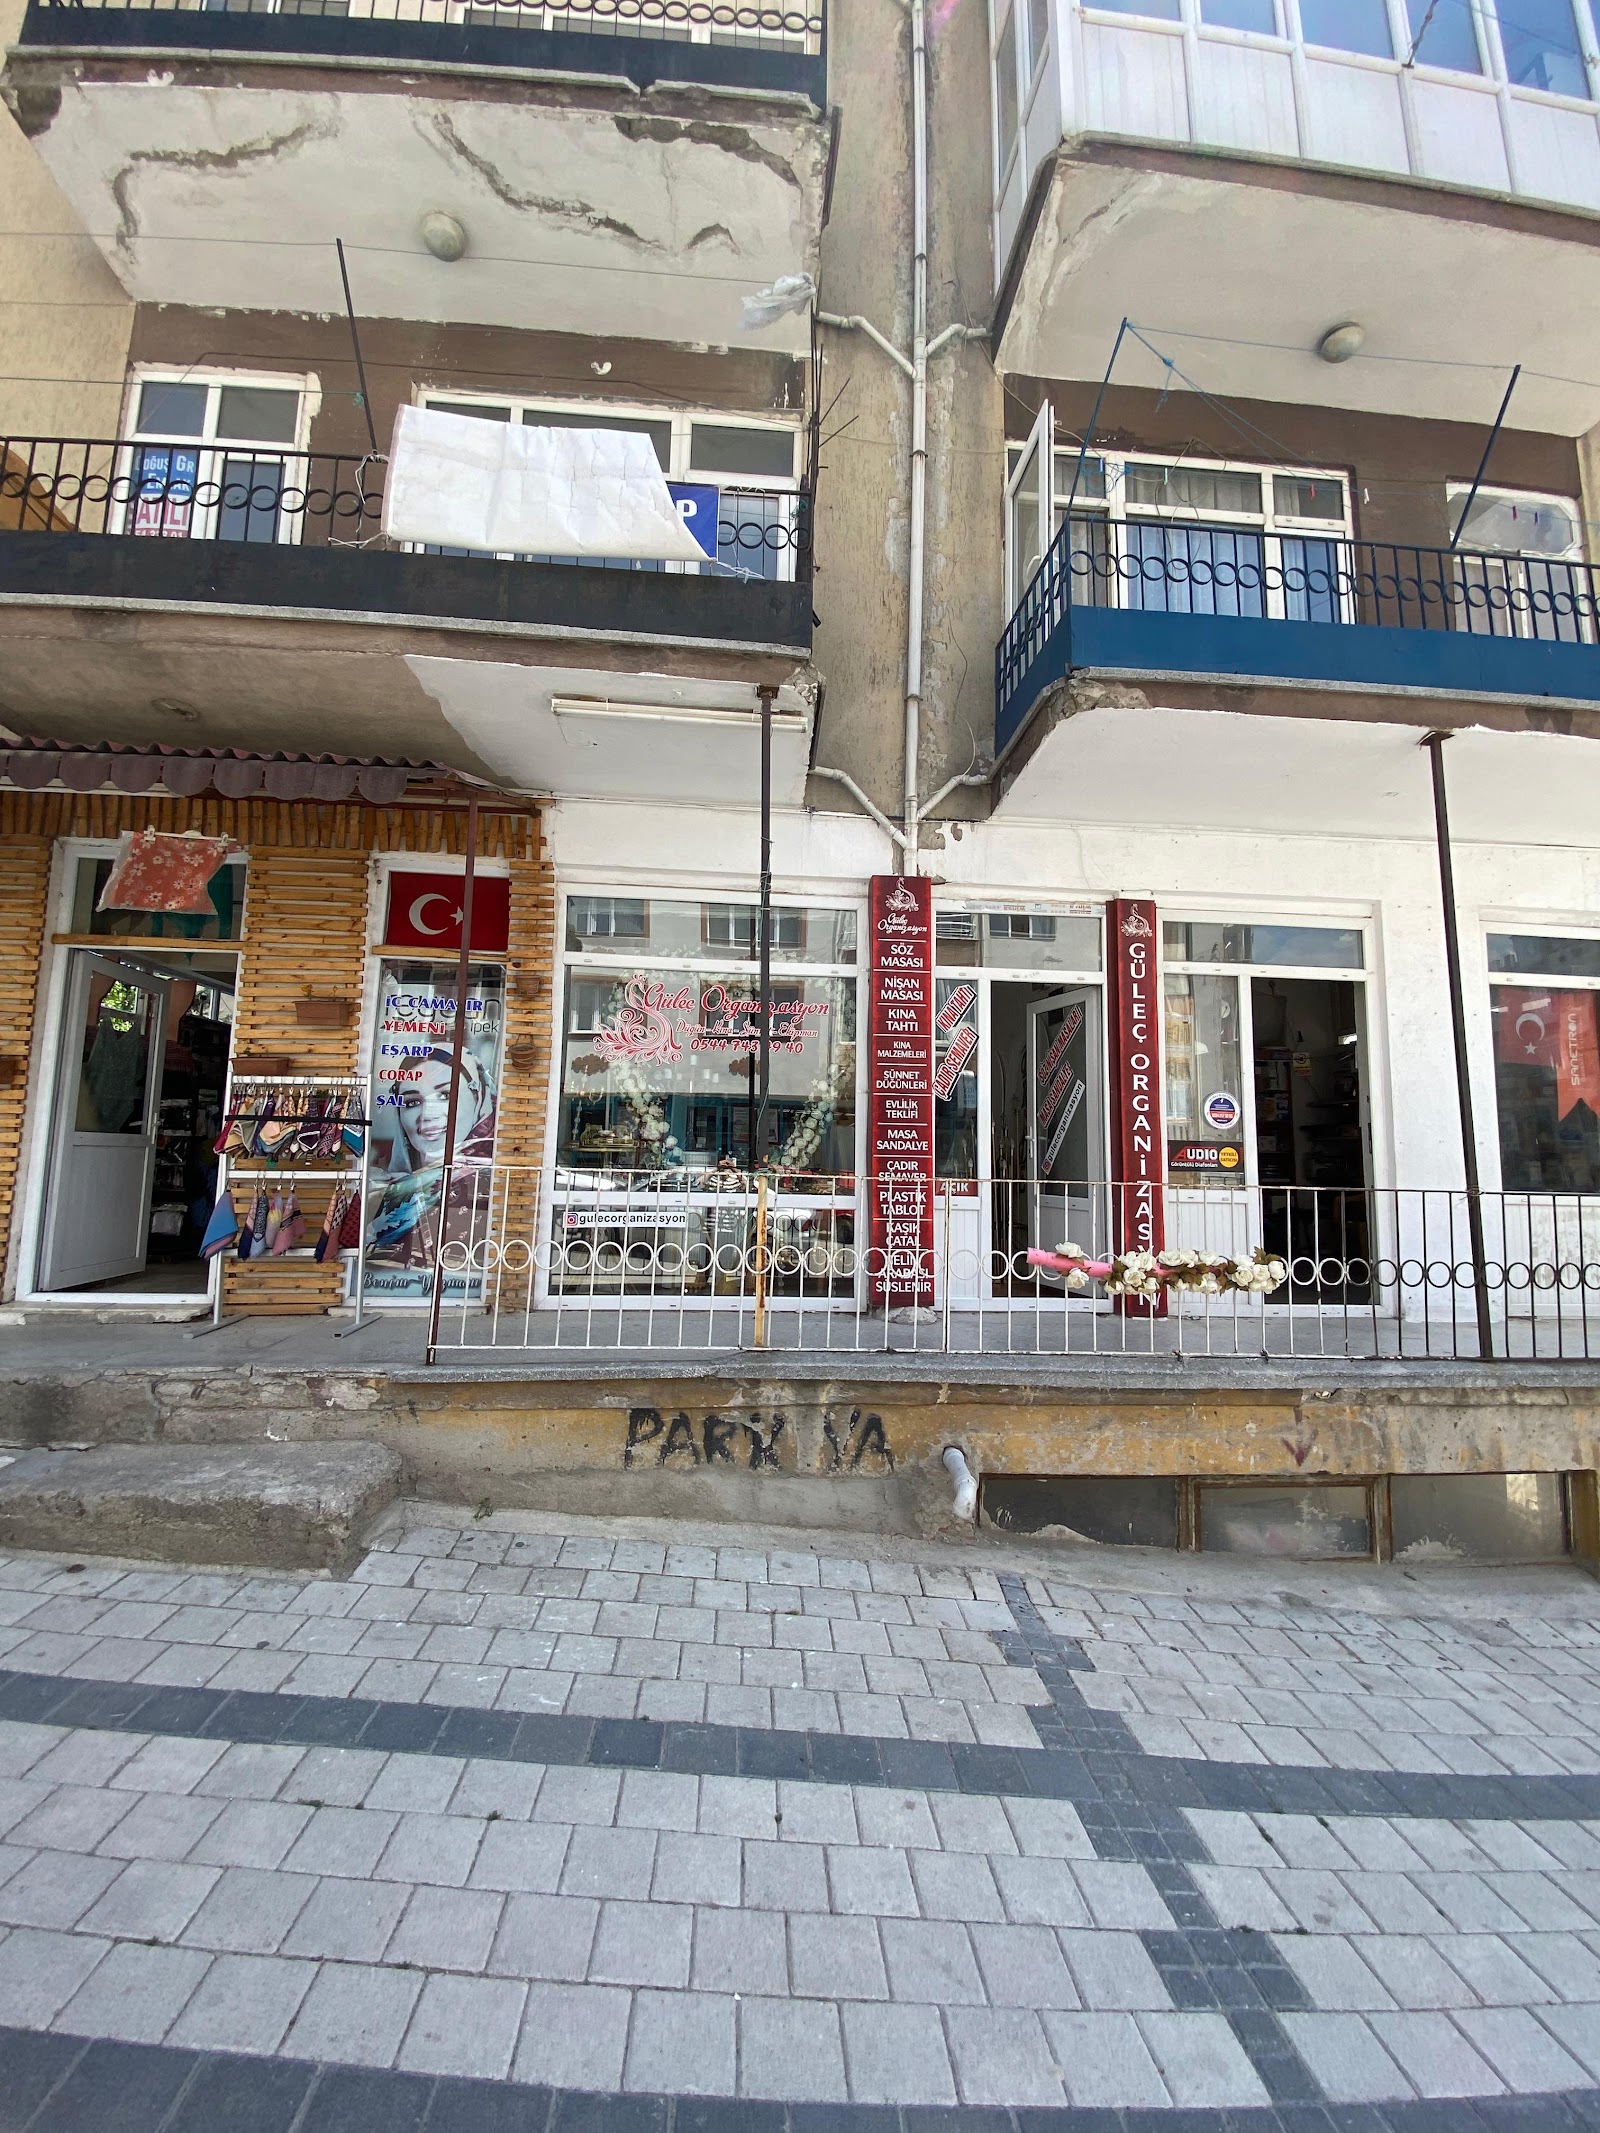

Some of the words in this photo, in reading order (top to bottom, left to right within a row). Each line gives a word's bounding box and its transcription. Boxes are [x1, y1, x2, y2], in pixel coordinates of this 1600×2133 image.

[147, 473, 190, 491] EMAK
[877, 919, 927, 935] Organizasyon
[891, 942, 914, 955] SÖZ
[881, 956, 923, 967] MASASI
[885, 975, 919, 990] NİŞAN
[881, 990, 923, 1000] MASASI
[1129, 943, 1148, 1043] GÜLEÇ
[408, 997, 483, 1011] ÇAMAIR
[644, 983, 696, 1013] Güleç
[702, 985, 829, 1022] Organzasyon
[888, 1008, 916, 1019] KINA
[937, 1003, 956, 1031] KINA
[470, 1021, 500, 1035] ipek
[886, 1021, 918, 1031] TAHTI
[690, 1039, 728, 1051] 0544
[732, 1040, 760, 1052] 743
[785, 1041, 803, 1053] 40
[894, 1041, 911, 1049] KINA
[946, 1028, 976, 1071] SEMAVER
[1567, 1013, 1580, 1086] SANETRON
[381, 1045, 433, 1058] EŞARP
[877, 1049, 926, 1058] MALZEMELERİ
[379, 1070, 423, 1083] ÇORAP
[883, 1069, 919, 1080] SÜNNET
[876, 1080, 927, 1089] DÜĞÜNLERİ
[376, 1095, 407, 1109] ŞAL
[886, 1099, 918, 1108] EVLİLİK
[886, 1109, 918, 1118] TEKLİFİ
[888, 1130, 918, 1139] MASA
[877, 1141, 929, 1150] SANDALYE
[1173, 1146, 1218, 1160] AUDIO
[887, 1161, 918, 1172] ÇADIR
[878, 1172, 926, 1182] SEMAVER
[940, 1181, 969, 1194] AÇIK
[880, 1190, 927, 1202] PLASTİK
[881, 1205, 925, 1215] TABLOT
[579, 1213, 686, 1225] gulecorganizasyon
[886, 1223, 920, 1235] KAŞIK
[886, 1236, 921, 1248] ÇATAL
[876, 1279, 931, 1292] SÜSLENİR
